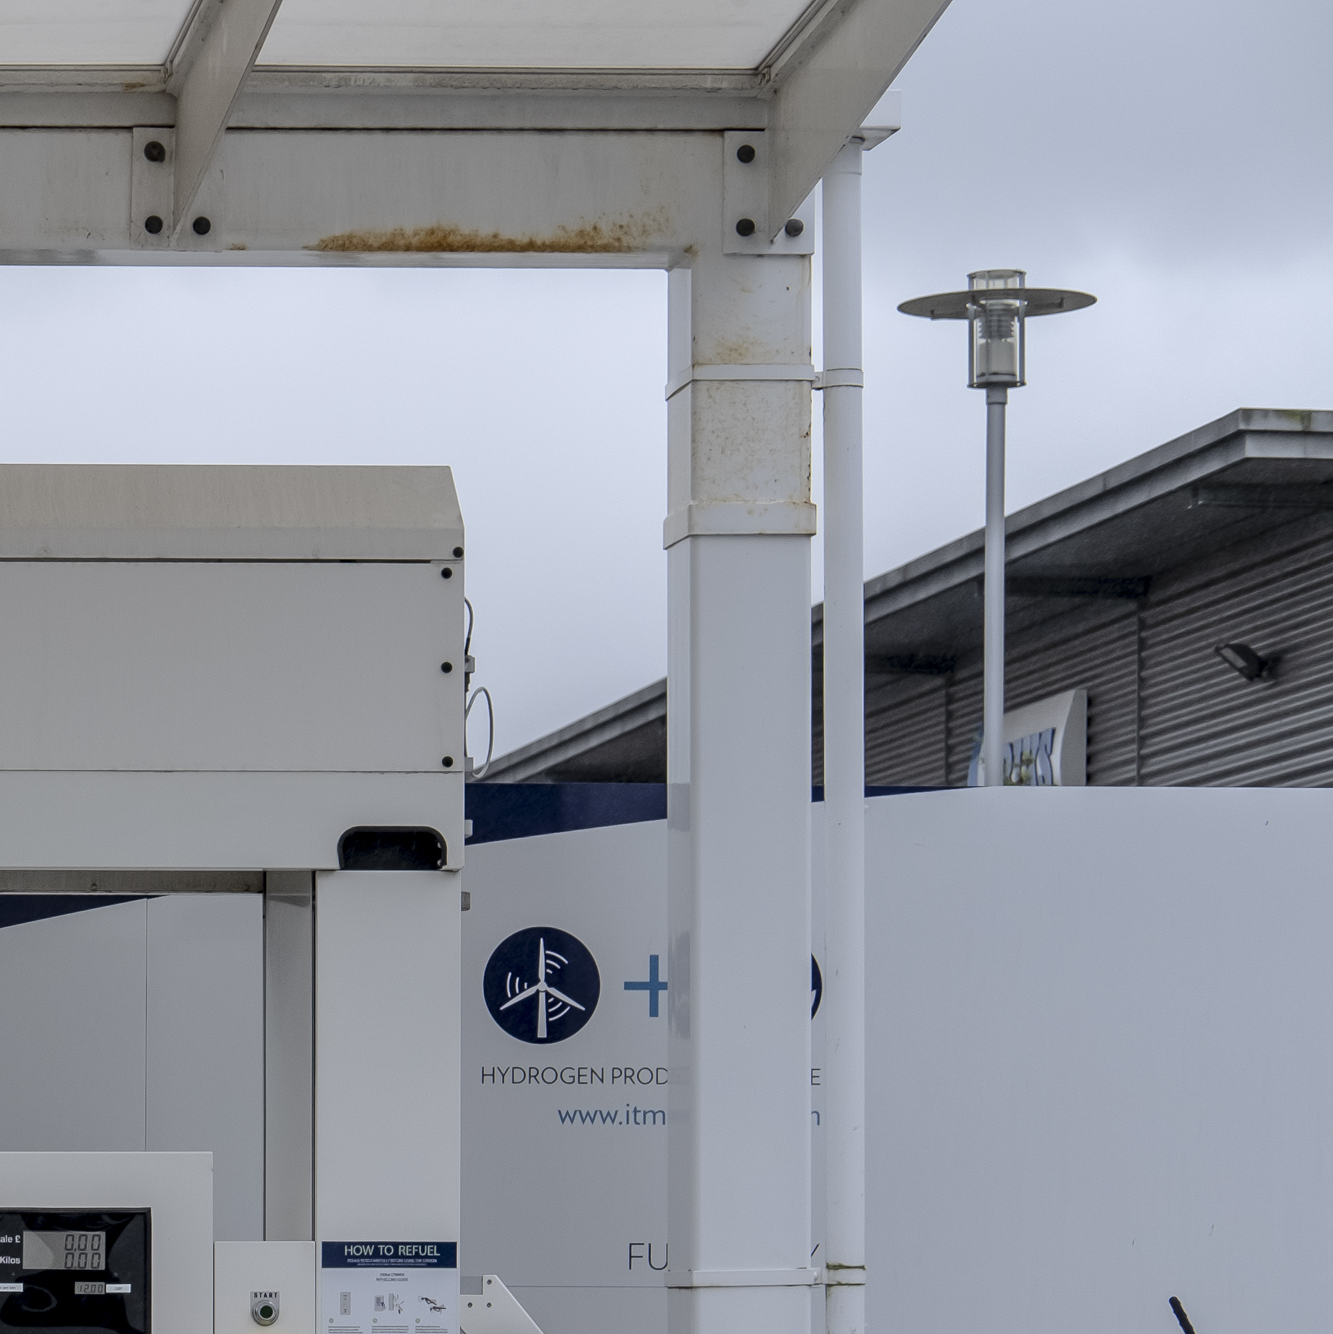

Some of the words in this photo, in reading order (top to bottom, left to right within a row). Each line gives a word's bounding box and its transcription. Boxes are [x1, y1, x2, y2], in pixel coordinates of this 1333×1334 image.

[480, 1066, 605, 1085] HYDROGEN
[611, 1066, 668, 1085] PROD
[557, 1103, 666, 1126] www.itm
[15, 1234, 21, 1243] £
[344, 1244, 374, 1256] HOW
[378, 1244, 394, 1256] TO
[398, 1244, 440, 1256] REFUEL
[629, 1243, 668, 1271] FU
[0, 1256, 21, 1265] Kilos
